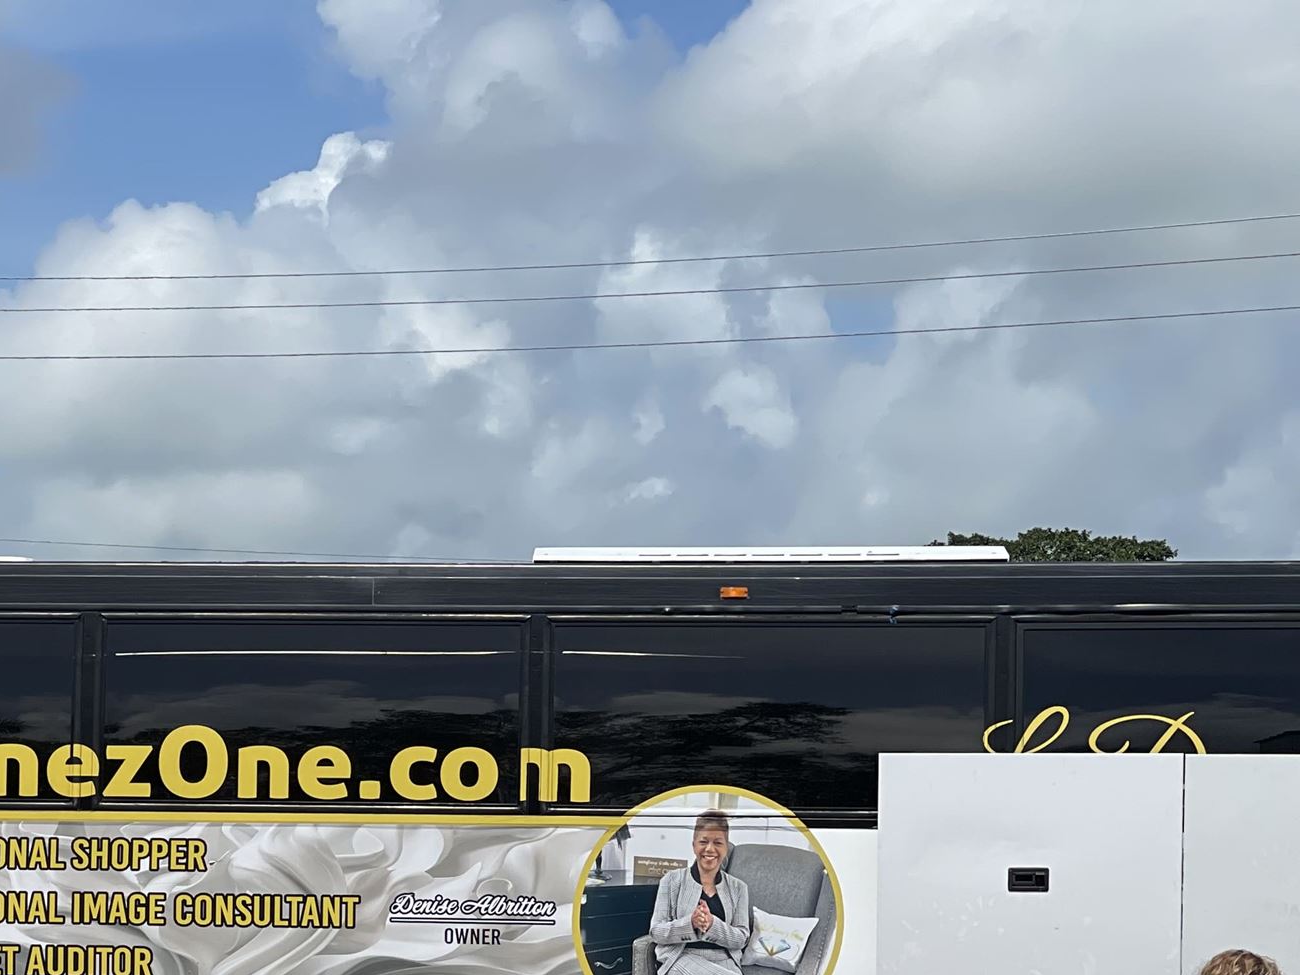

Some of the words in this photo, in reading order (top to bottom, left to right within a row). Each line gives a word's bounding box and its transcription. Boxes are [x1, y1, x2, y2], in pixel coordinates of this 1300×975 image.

[70, 836, 208, 872] SHOPPER
[70, 891, 167, 926] IMAGE
[173, 892, 361, 929] CONSULTANT
[389, 892, 459, 916] Denise
[460, 894, 557, 917] Albritton
[444, 927, 501, 946] OWNER
